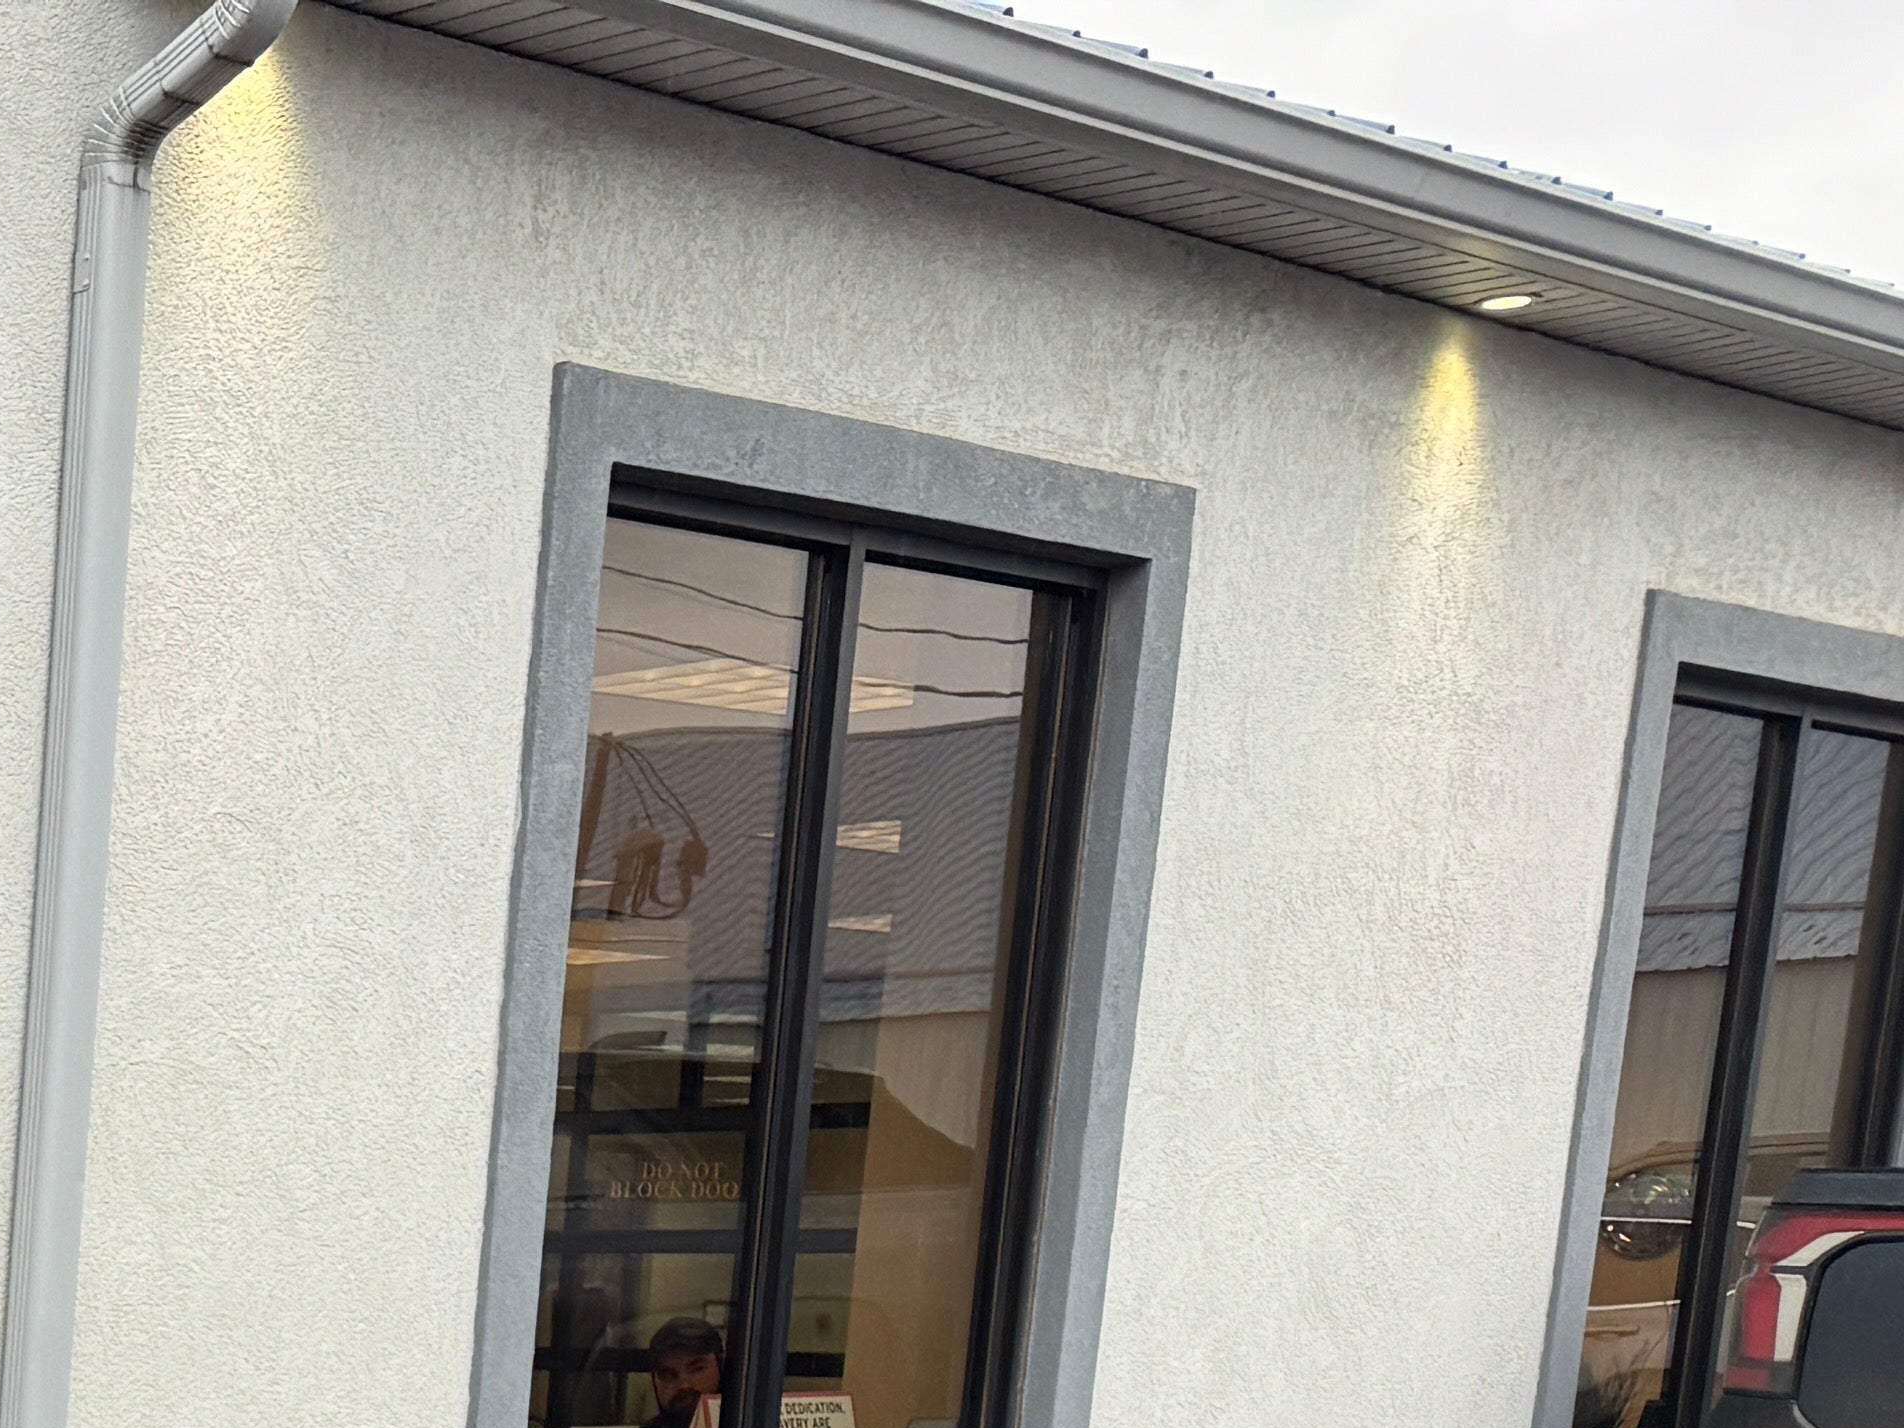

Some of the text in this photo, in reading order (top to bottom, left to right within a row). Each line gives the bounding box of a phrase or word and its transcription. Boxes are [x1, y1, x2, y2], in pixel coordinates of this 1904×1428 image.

[643, 1161, 724, 1180] DO NOT
[610, 1180, 683, 1199] BLOCK
